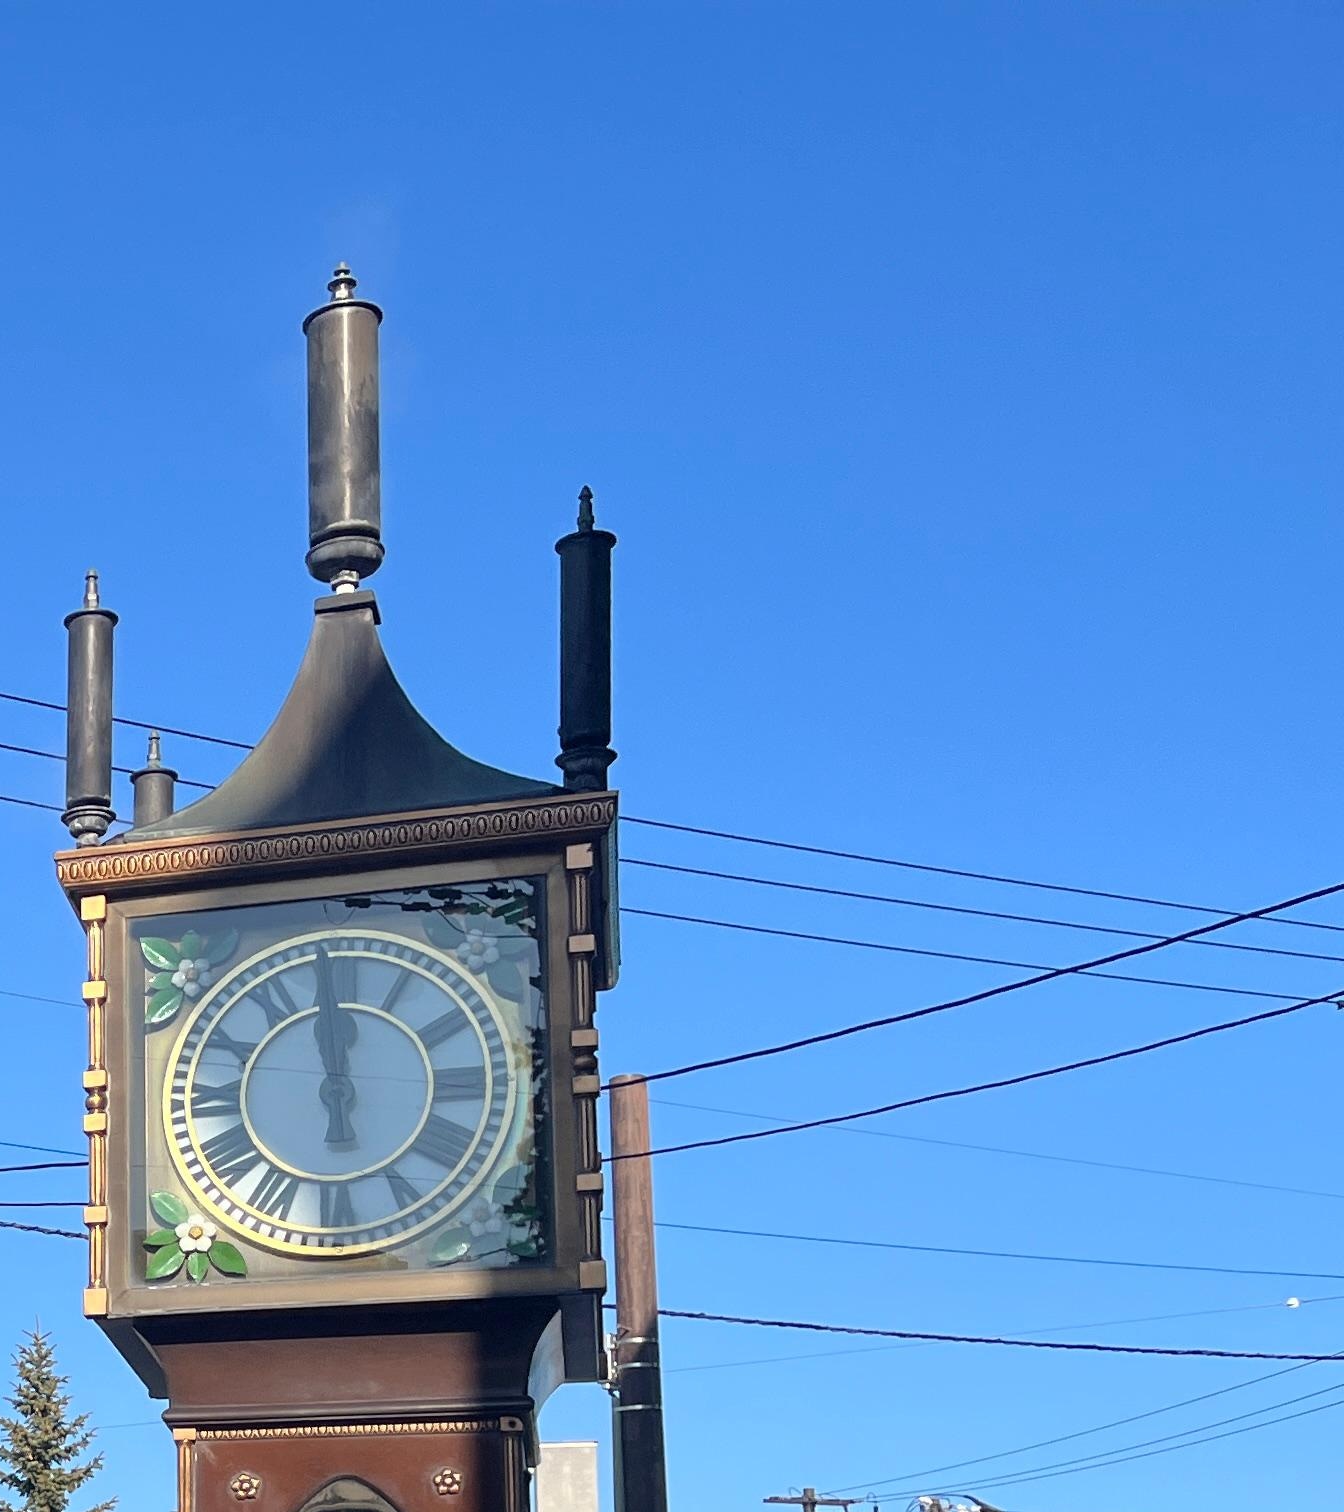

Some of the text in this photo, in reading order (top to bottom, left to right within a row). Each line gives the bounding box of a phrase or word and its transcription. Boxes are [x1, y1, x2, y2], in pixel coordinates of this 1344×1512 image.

[245, 971, 298, 1032] XI
[202, 1024, 259, 1065] X
[191, 1079, 243, 1118] IX
[199, 1123, 263, 1190] VIII
[246, 1165, 300, 1222] VII
[320, 1182, 354, 1227] VI
[384, 1166, 424, 1212] V
